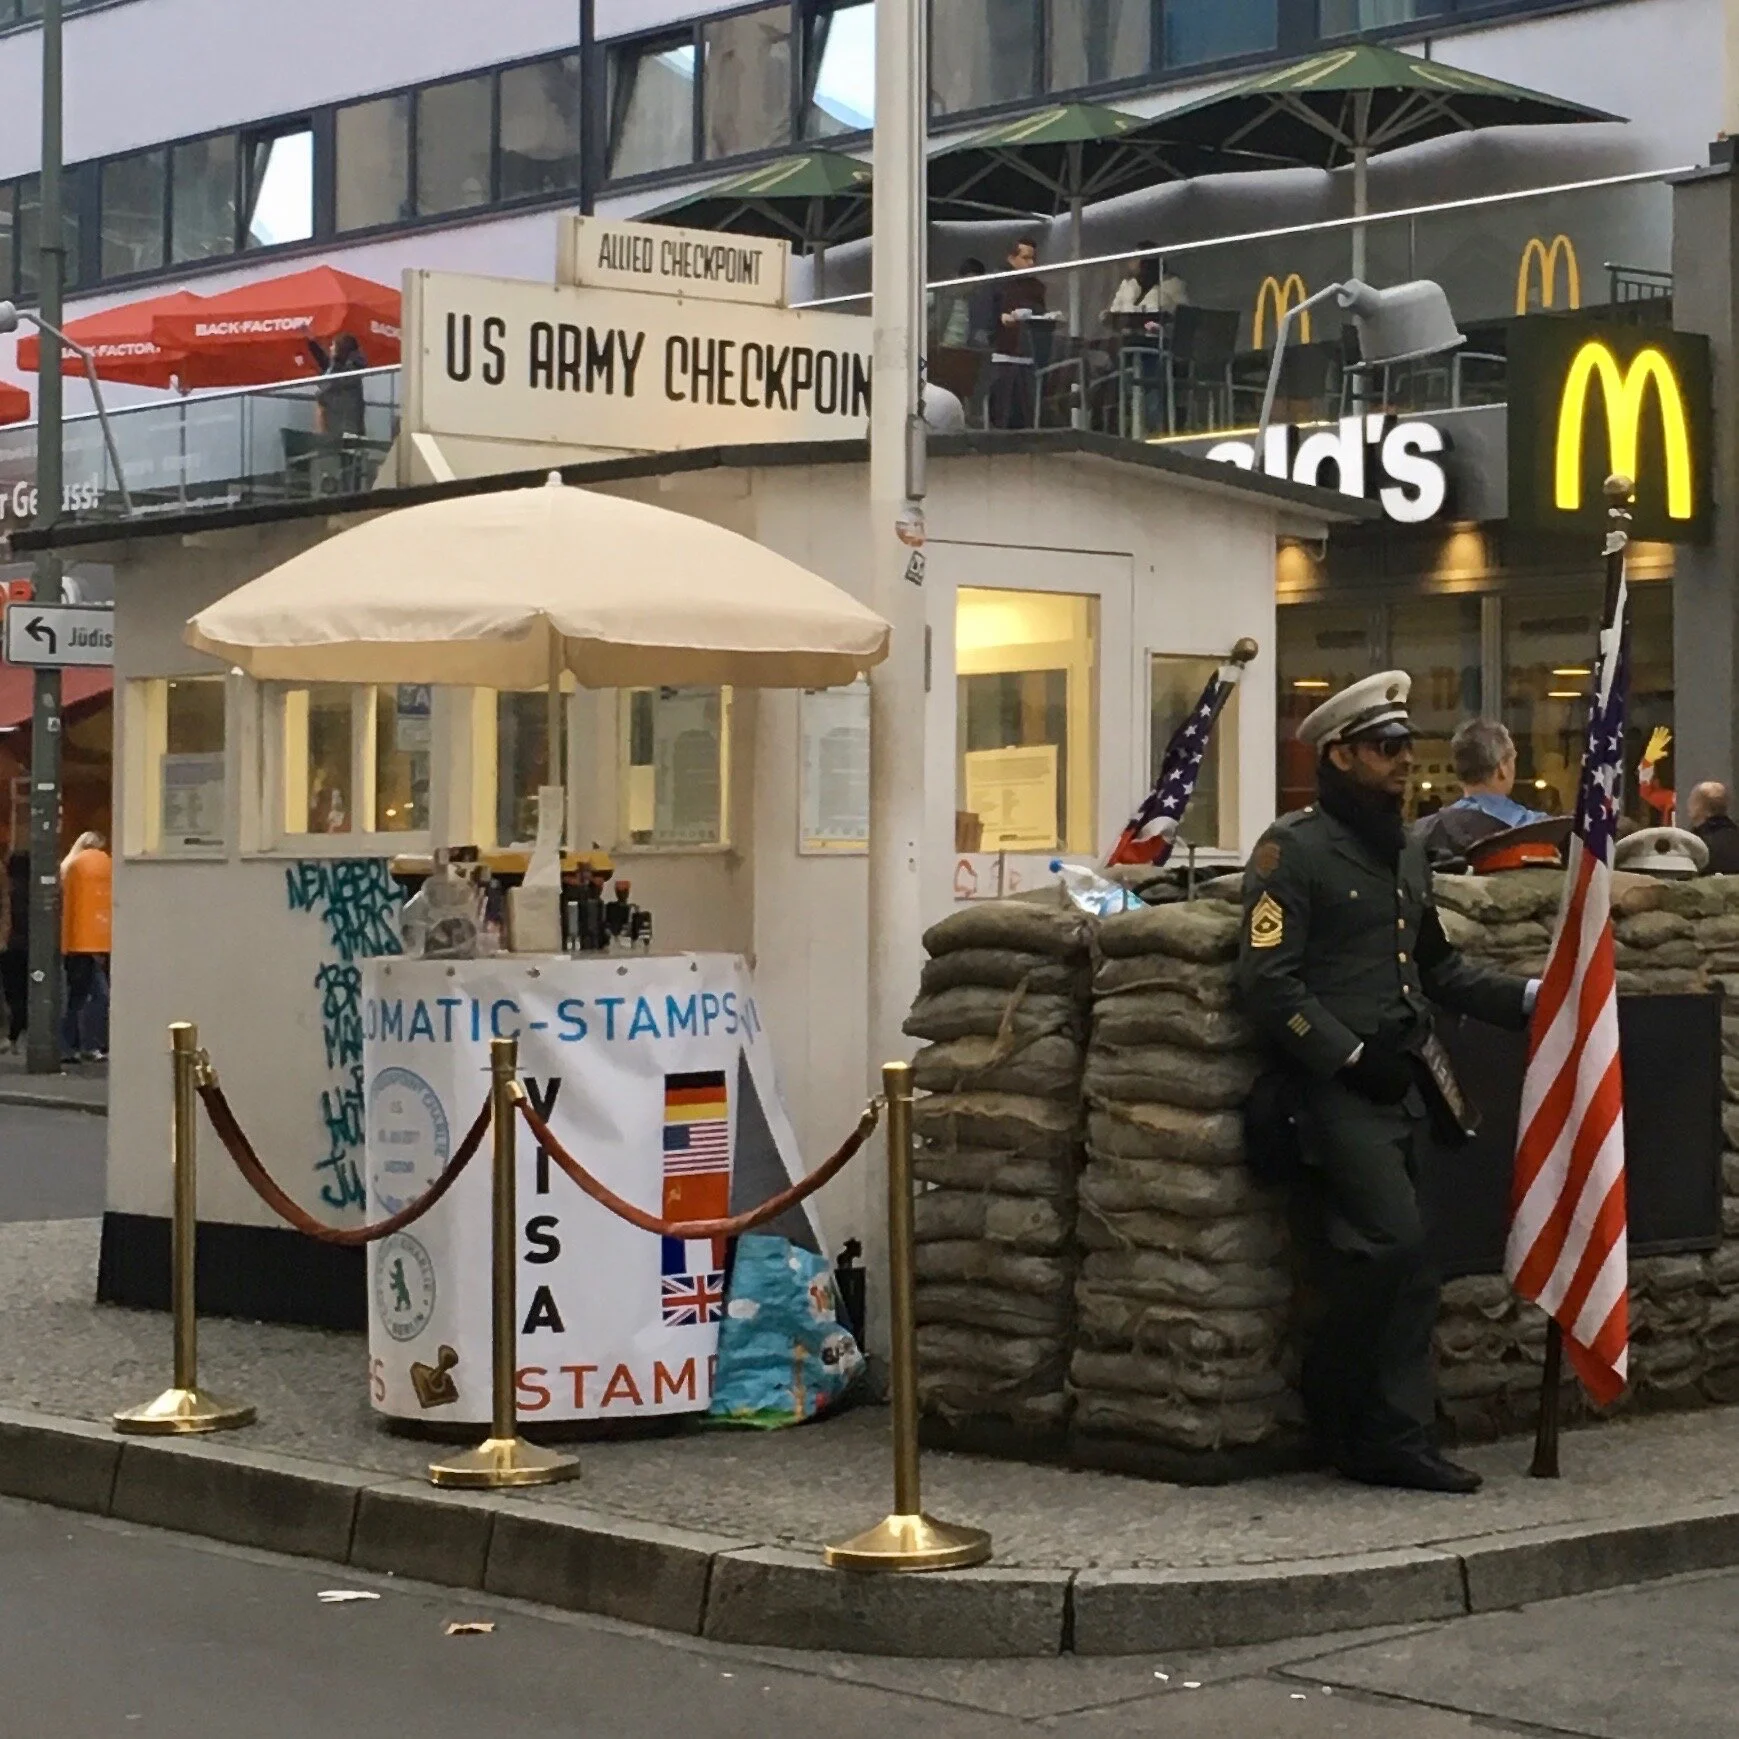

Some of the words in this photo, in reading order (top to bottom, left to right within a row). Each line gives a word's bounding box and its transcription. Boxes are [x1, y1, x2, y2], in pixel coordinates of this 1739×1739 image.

[598, 232, 653, 274] ALLIED
[660, 239, 763, 286] CHECKPOINT
[446, 311, 507, 386] US
[529, 320, 646, 398] ARMY
[664, 335, 873, 418] CHECKPOIN
[67, 625, 113, 649] Jüdis
[521, 1076, 566, 1335] VISA
